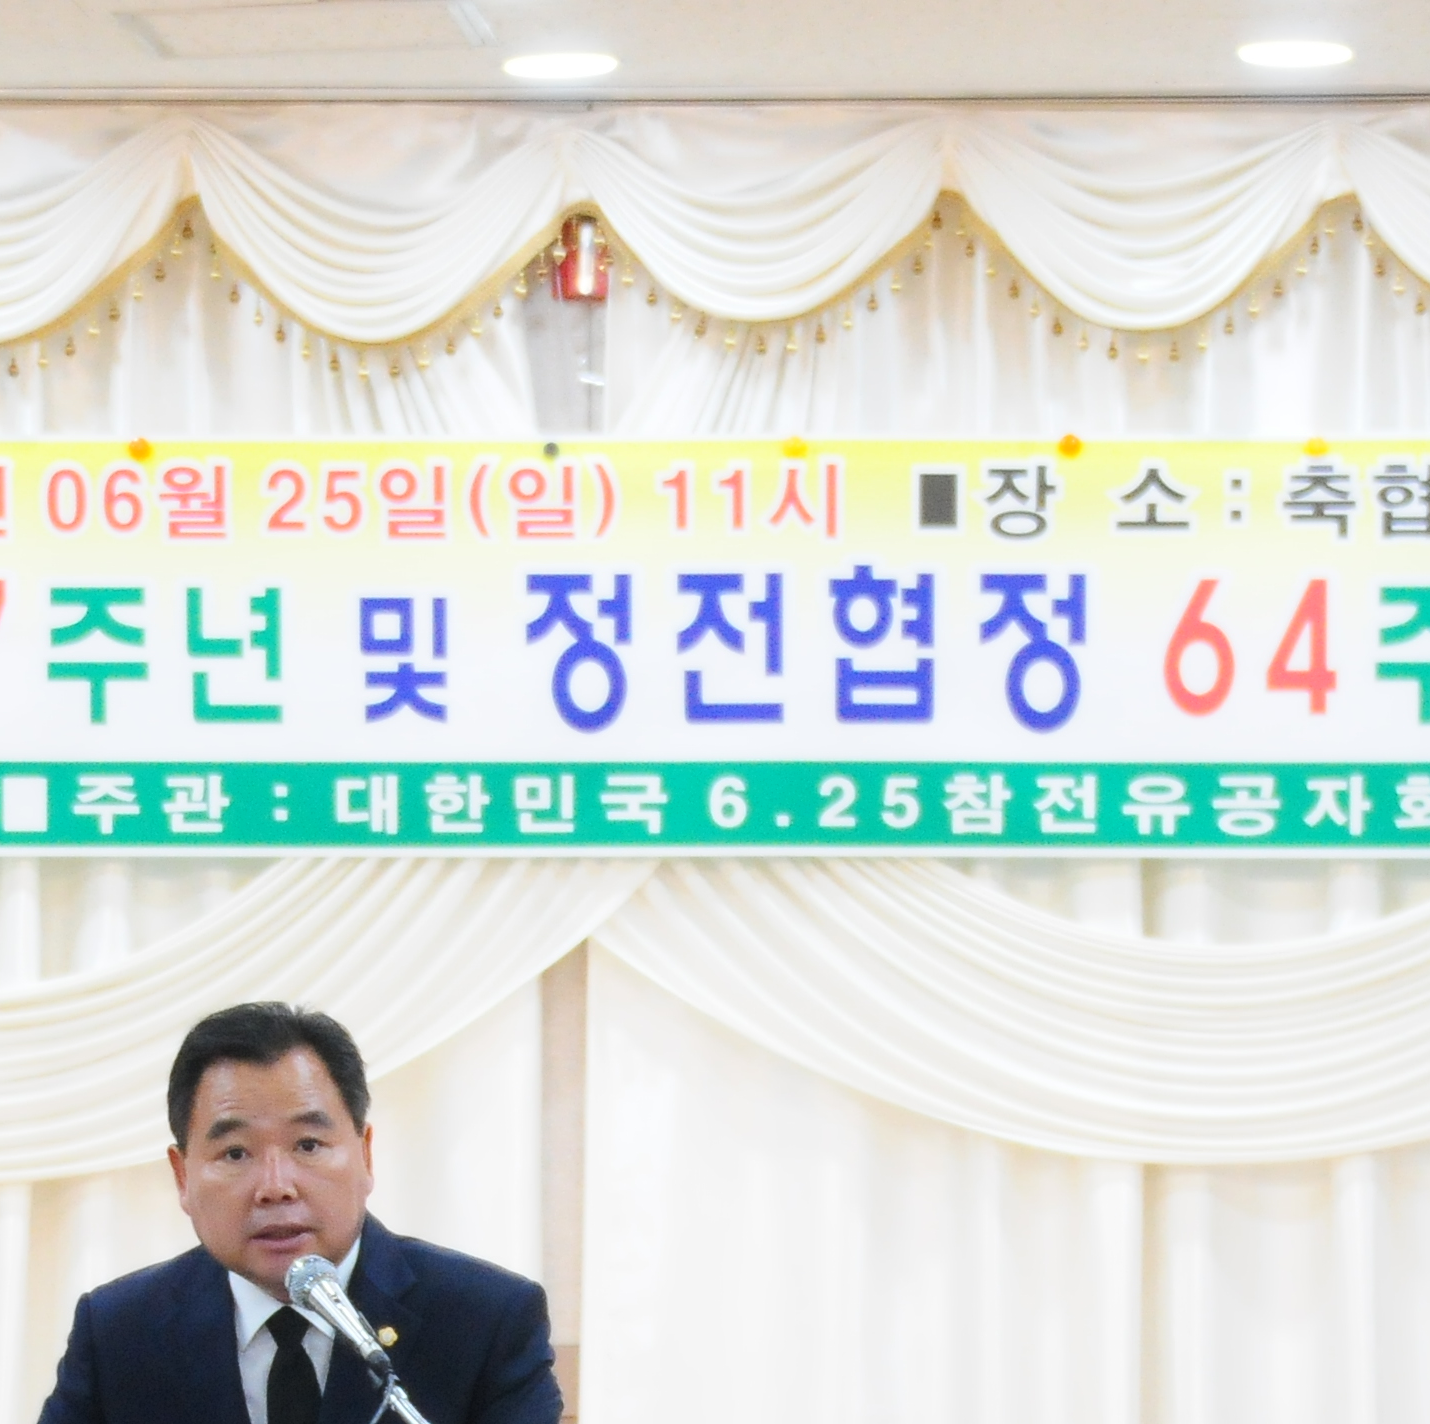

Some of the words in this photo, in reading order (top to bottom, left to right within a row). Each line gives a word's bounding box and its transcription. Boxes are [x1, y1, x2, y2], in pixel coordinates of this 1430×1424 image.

[47, 464, 225, 538] 06월
[268, 465, 615, 538] 25일(일)
[664, 464, 837, 537] 11시
[359, 597, 448, 722] 및
[525, 564, 1087, 734] 정전협정
[335, 774, 668, 834] 대한민국
